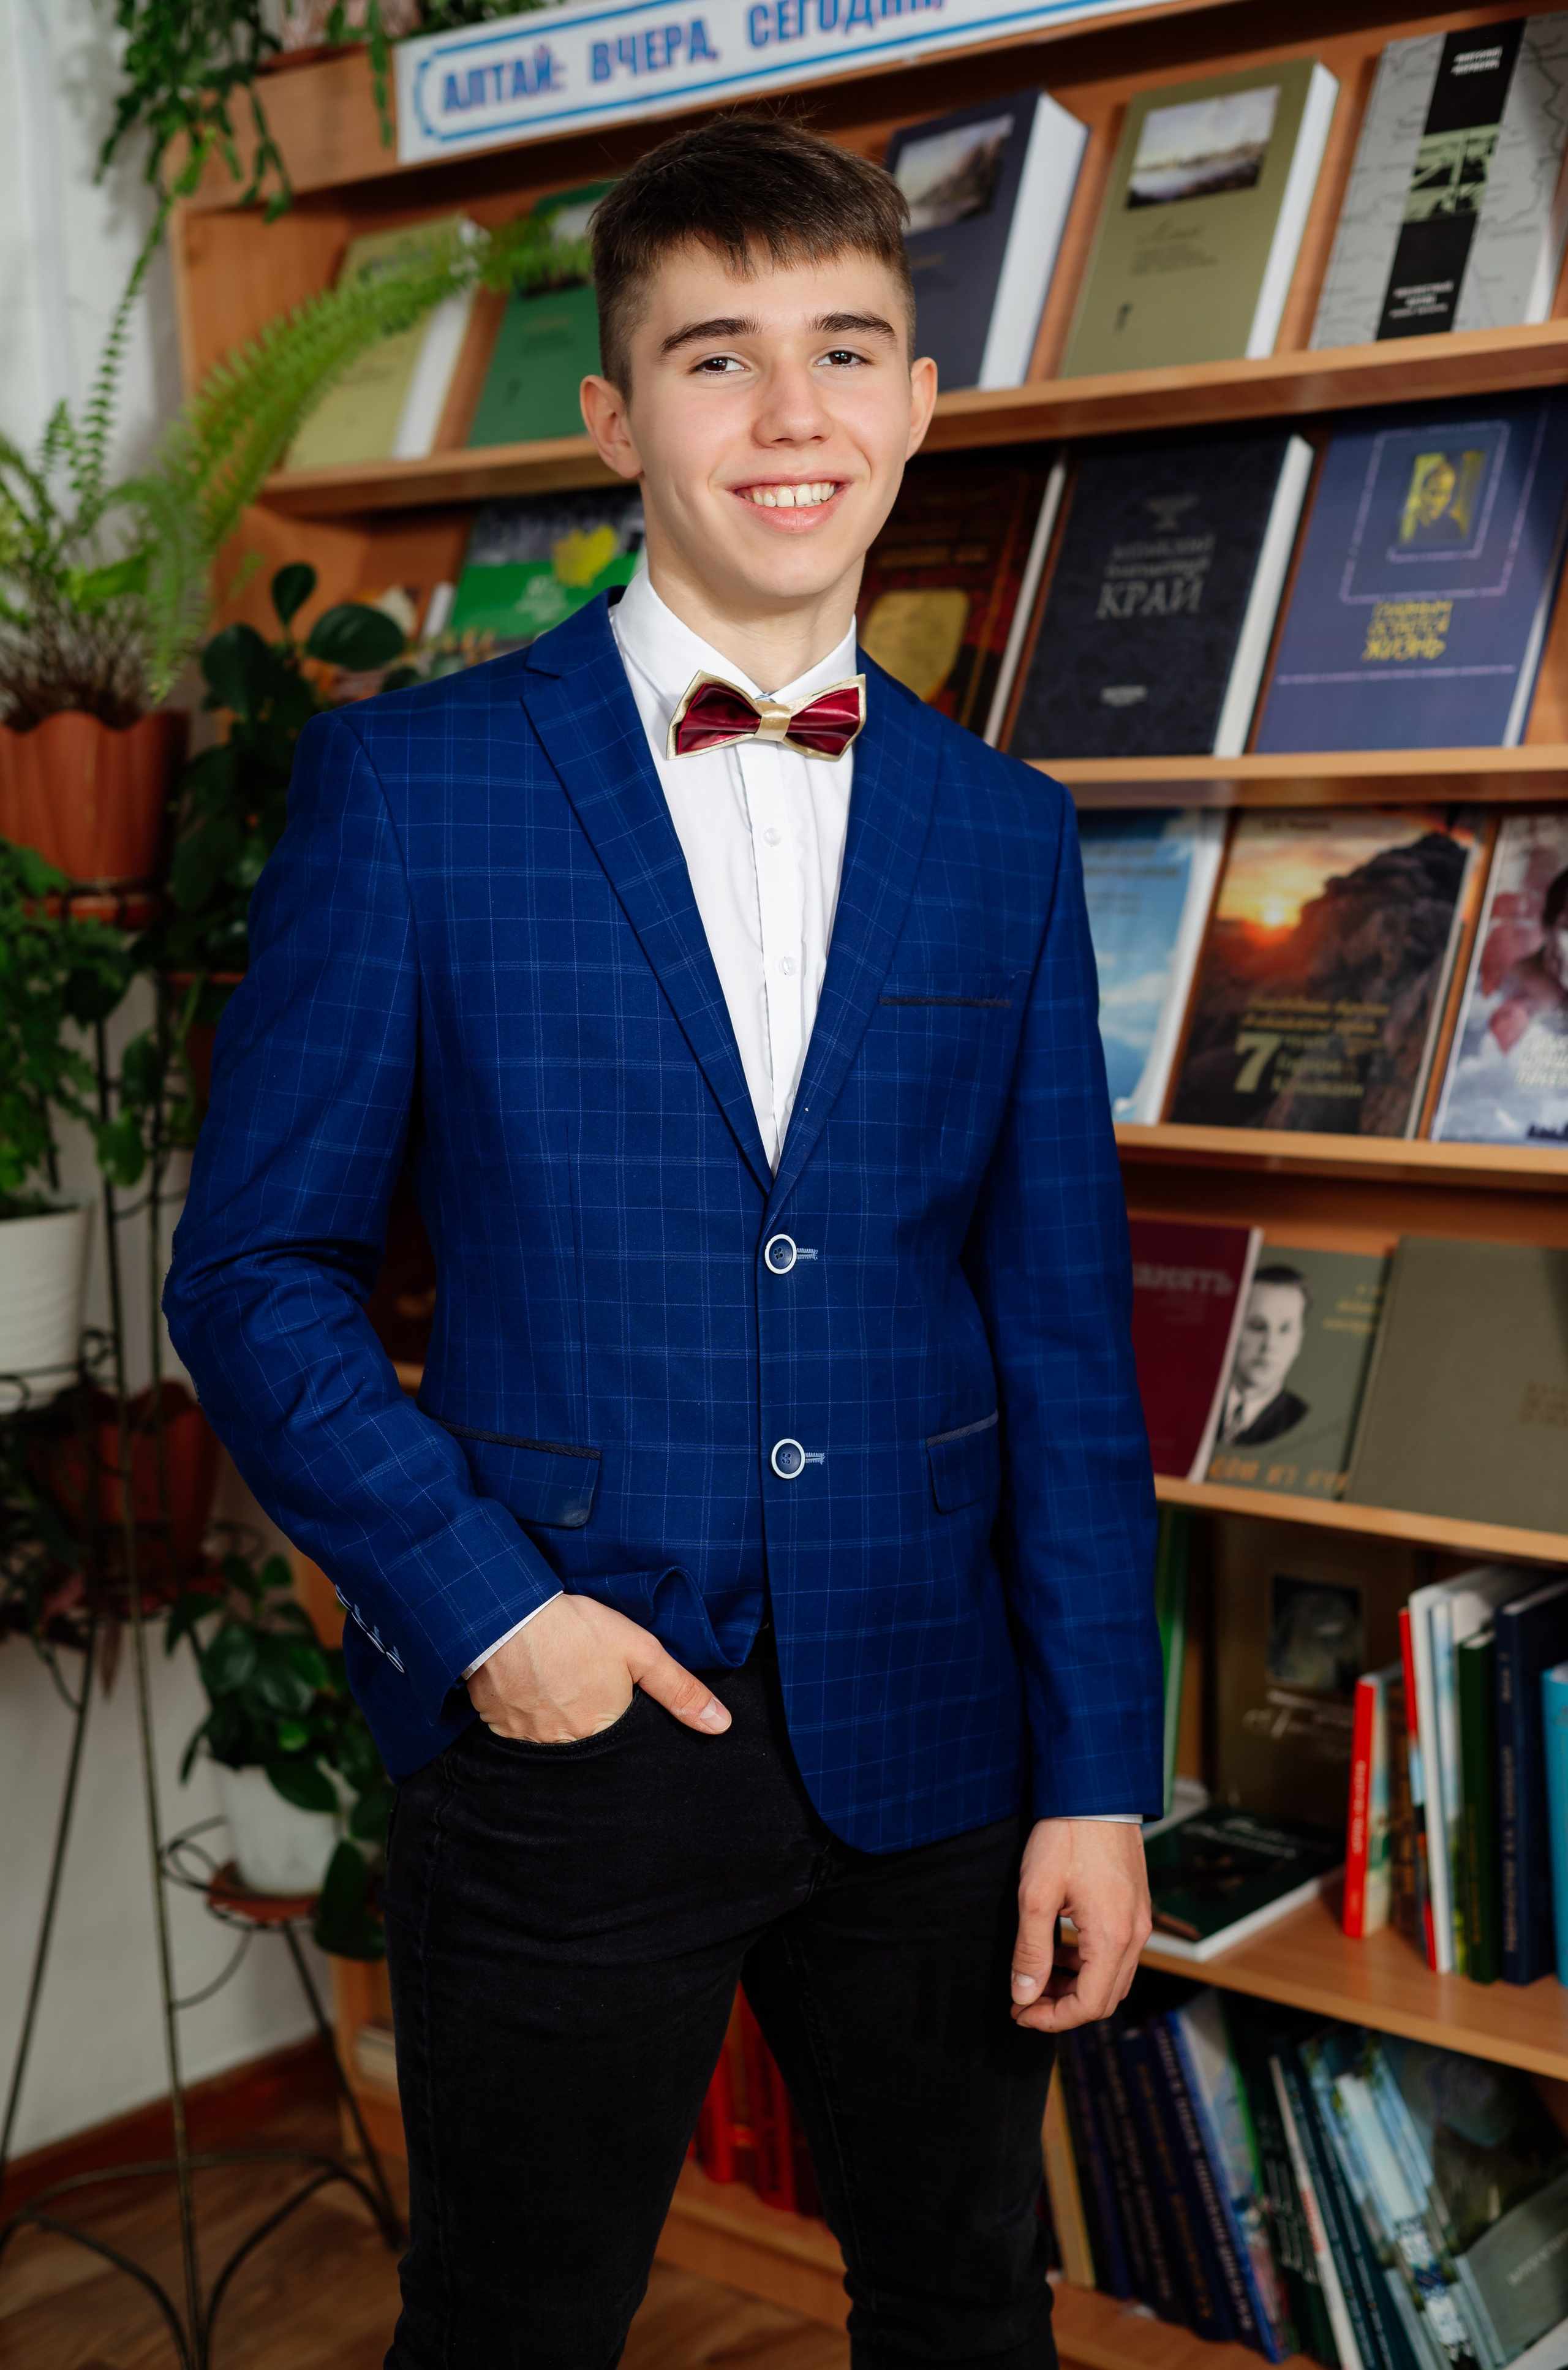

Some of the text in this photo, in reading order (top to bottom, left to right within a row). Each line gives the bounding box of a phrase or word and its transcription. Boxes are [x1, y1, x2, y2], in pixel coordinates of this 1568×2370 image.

[443, 44, 564, 113] АЛТАЙ:
[591, 18, 718, 83] ВЧЕРА,
[1234, 1032, 1280, 1093] 7
